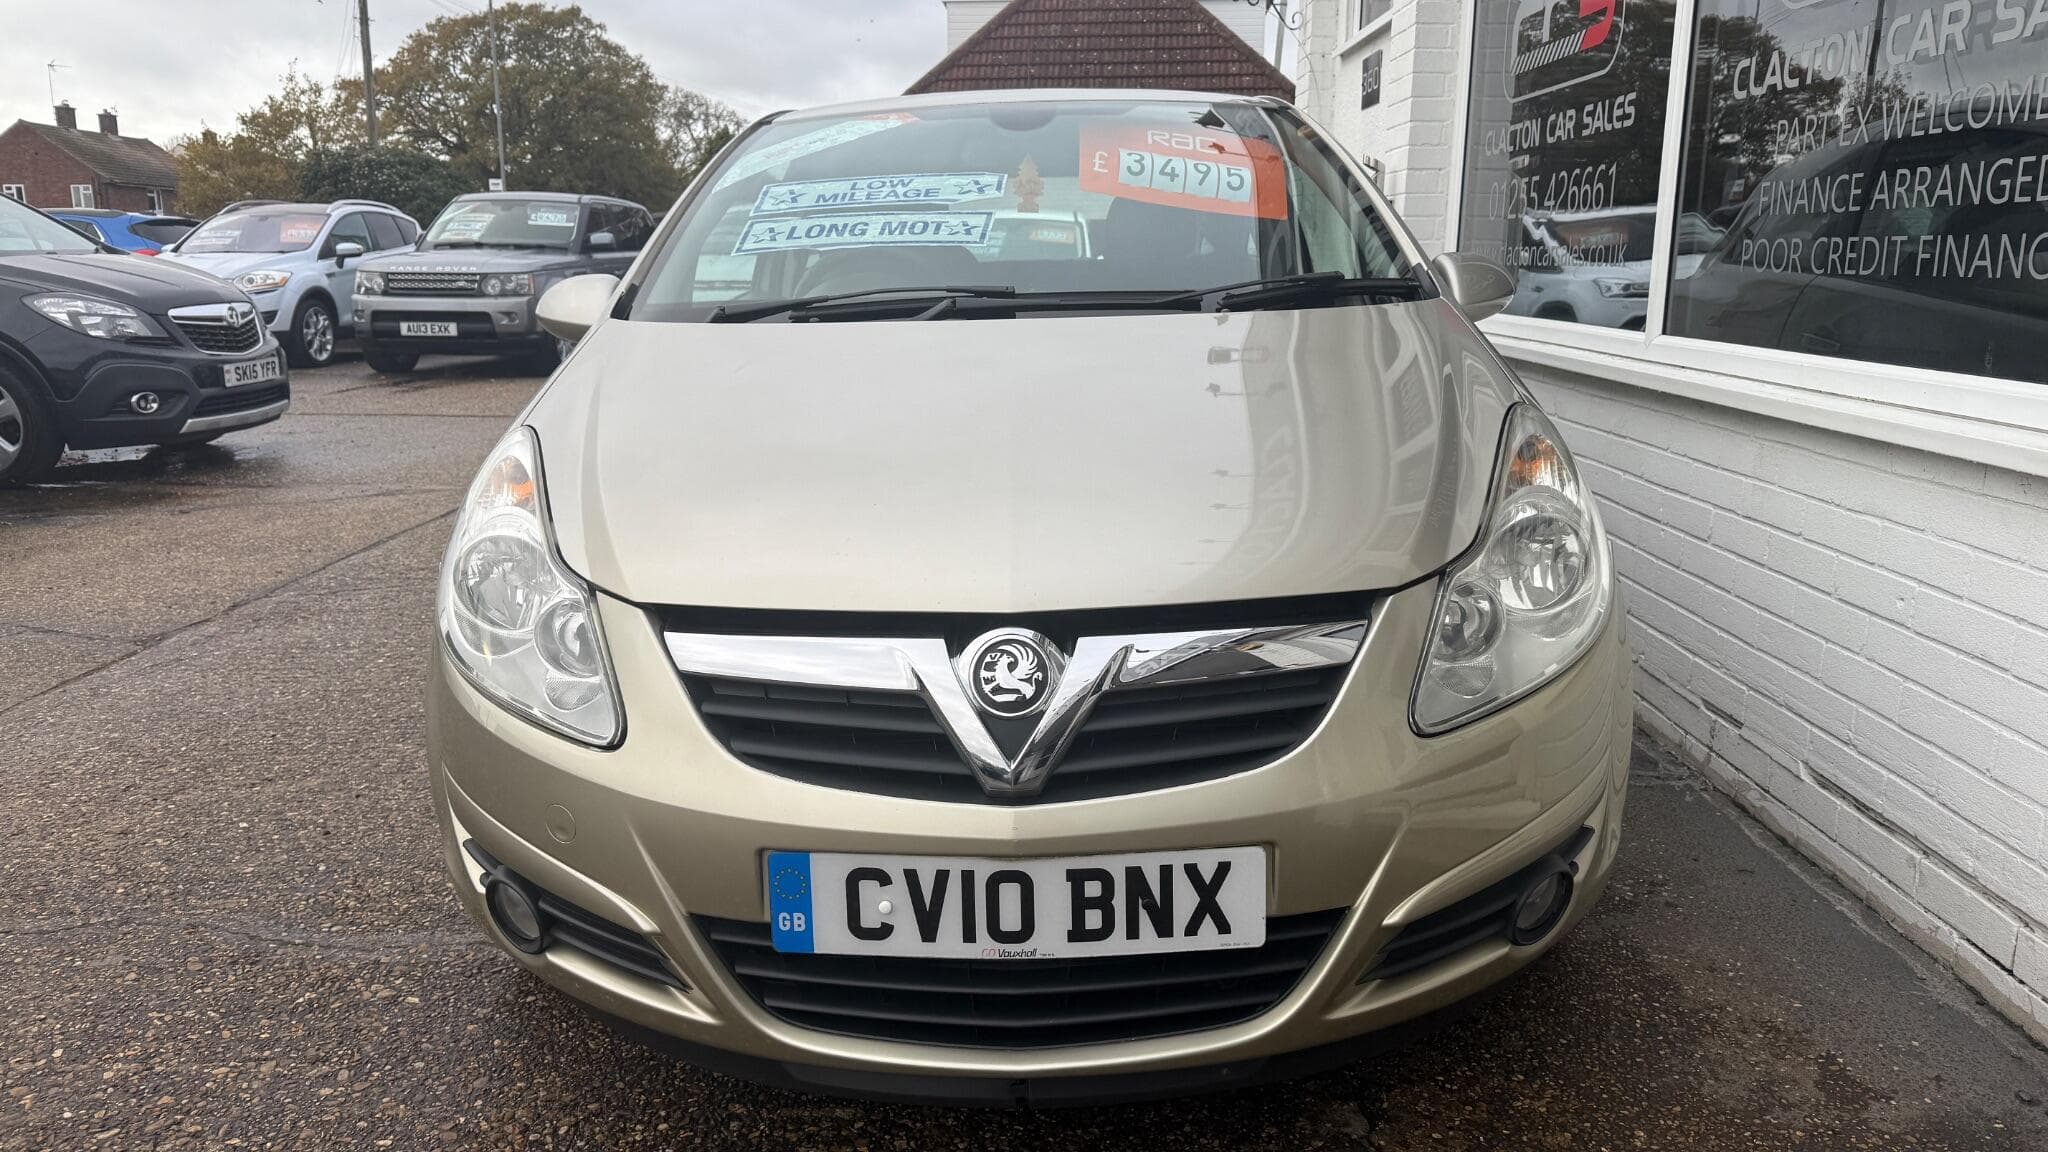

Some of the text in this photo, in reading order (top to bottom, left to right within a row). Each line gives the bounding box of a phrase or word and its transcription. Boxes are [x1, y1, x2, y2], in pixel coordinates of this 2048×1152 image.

[1733, 25, 1872, 100] CLACTON
[1886, 0, 1973, 65] CAR
[1485, 92, 1637, 157] CLACTON CAR SALES
[1775, 109, 1833, 154] PART
[1839, 103, 1874, 147] EX
[849, 178, 914, 191] LOW
[1126, 151, 1245, 192] 3495
[1489, 161, 1618, 221] 01255 426661
[815, 187, 942, 204] MILEAGE
[1758, 172, 1865, 217] FINANCE
[785, 219, 949, 241] LONG MOT
[1740, 238, 1804, 273] POOR
[1811, 235, 1908, 276] CREDIT
[406, 323, 451, 334] AU13 EXK
[234, 360, 278, 382] SK15 YFR
[778, 912, 807, 932] GB
[845, 860, 1232, 945] CV10 BNX
[998, 947, 1038, 958] Vauxhall
